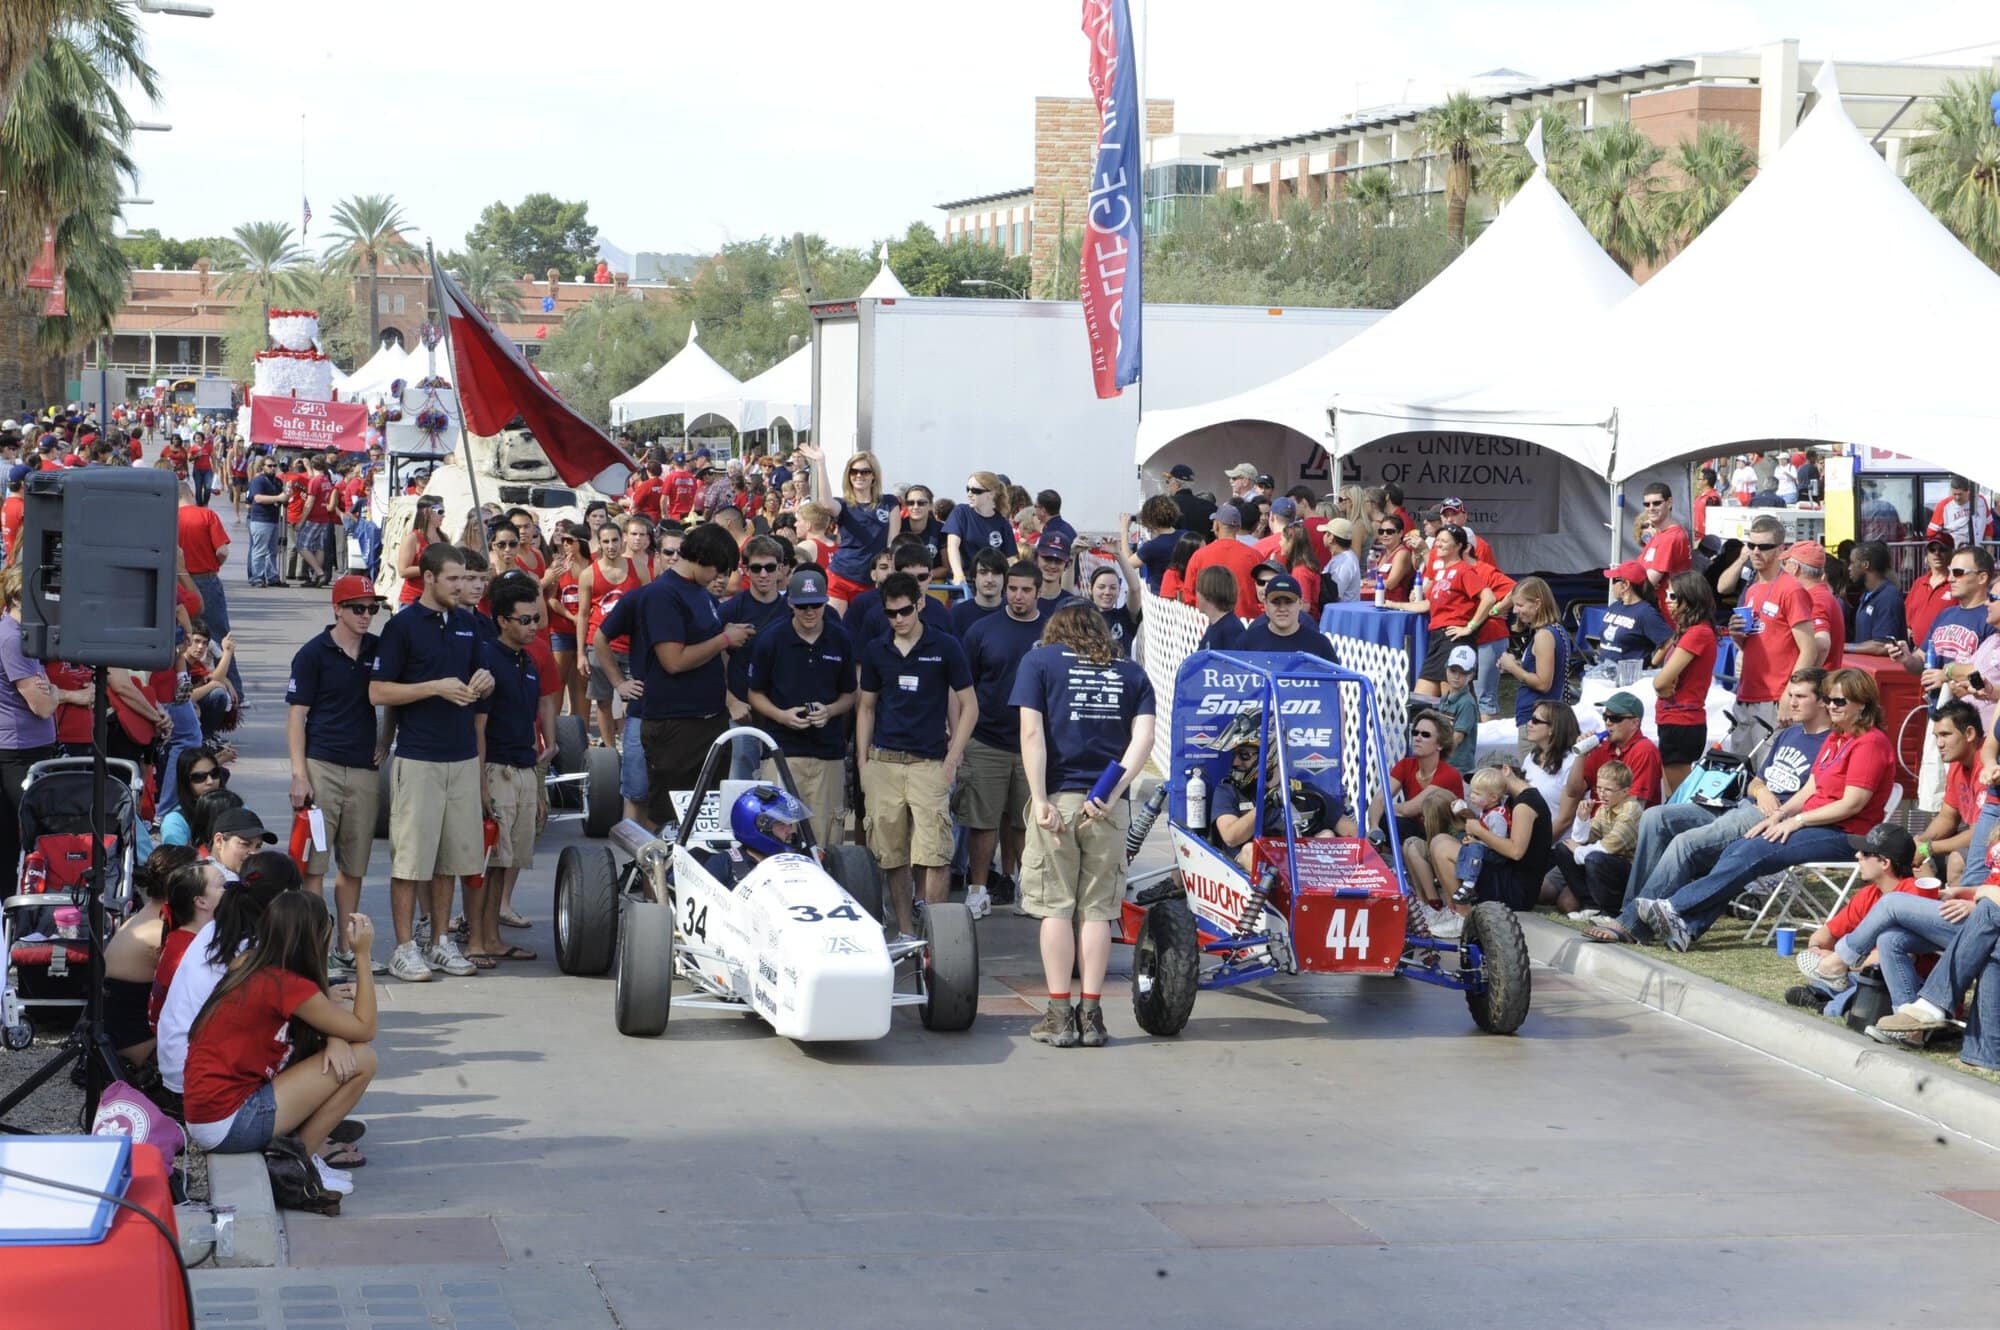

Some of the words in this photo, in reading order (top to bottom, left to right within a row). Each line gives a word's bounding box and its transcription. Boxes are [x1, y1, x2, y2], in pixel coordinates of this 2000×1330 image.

[273, 416, 305, 430] Safe
[311, 419, 344, 433] Ride
[1381, 463, 1412, 483] OF
[1418, 461, 1524, 485] ARIZONA
[1203, 669, 1320, 692] Rayteon
[1196, 694, 1322, 715] Sna-on
[1288, 728, 1332, 747] SAE
[683, 896, 708, 944] 34
[788, 905, 862, 922] 34
[1326, 908, 1370, 960] 44
